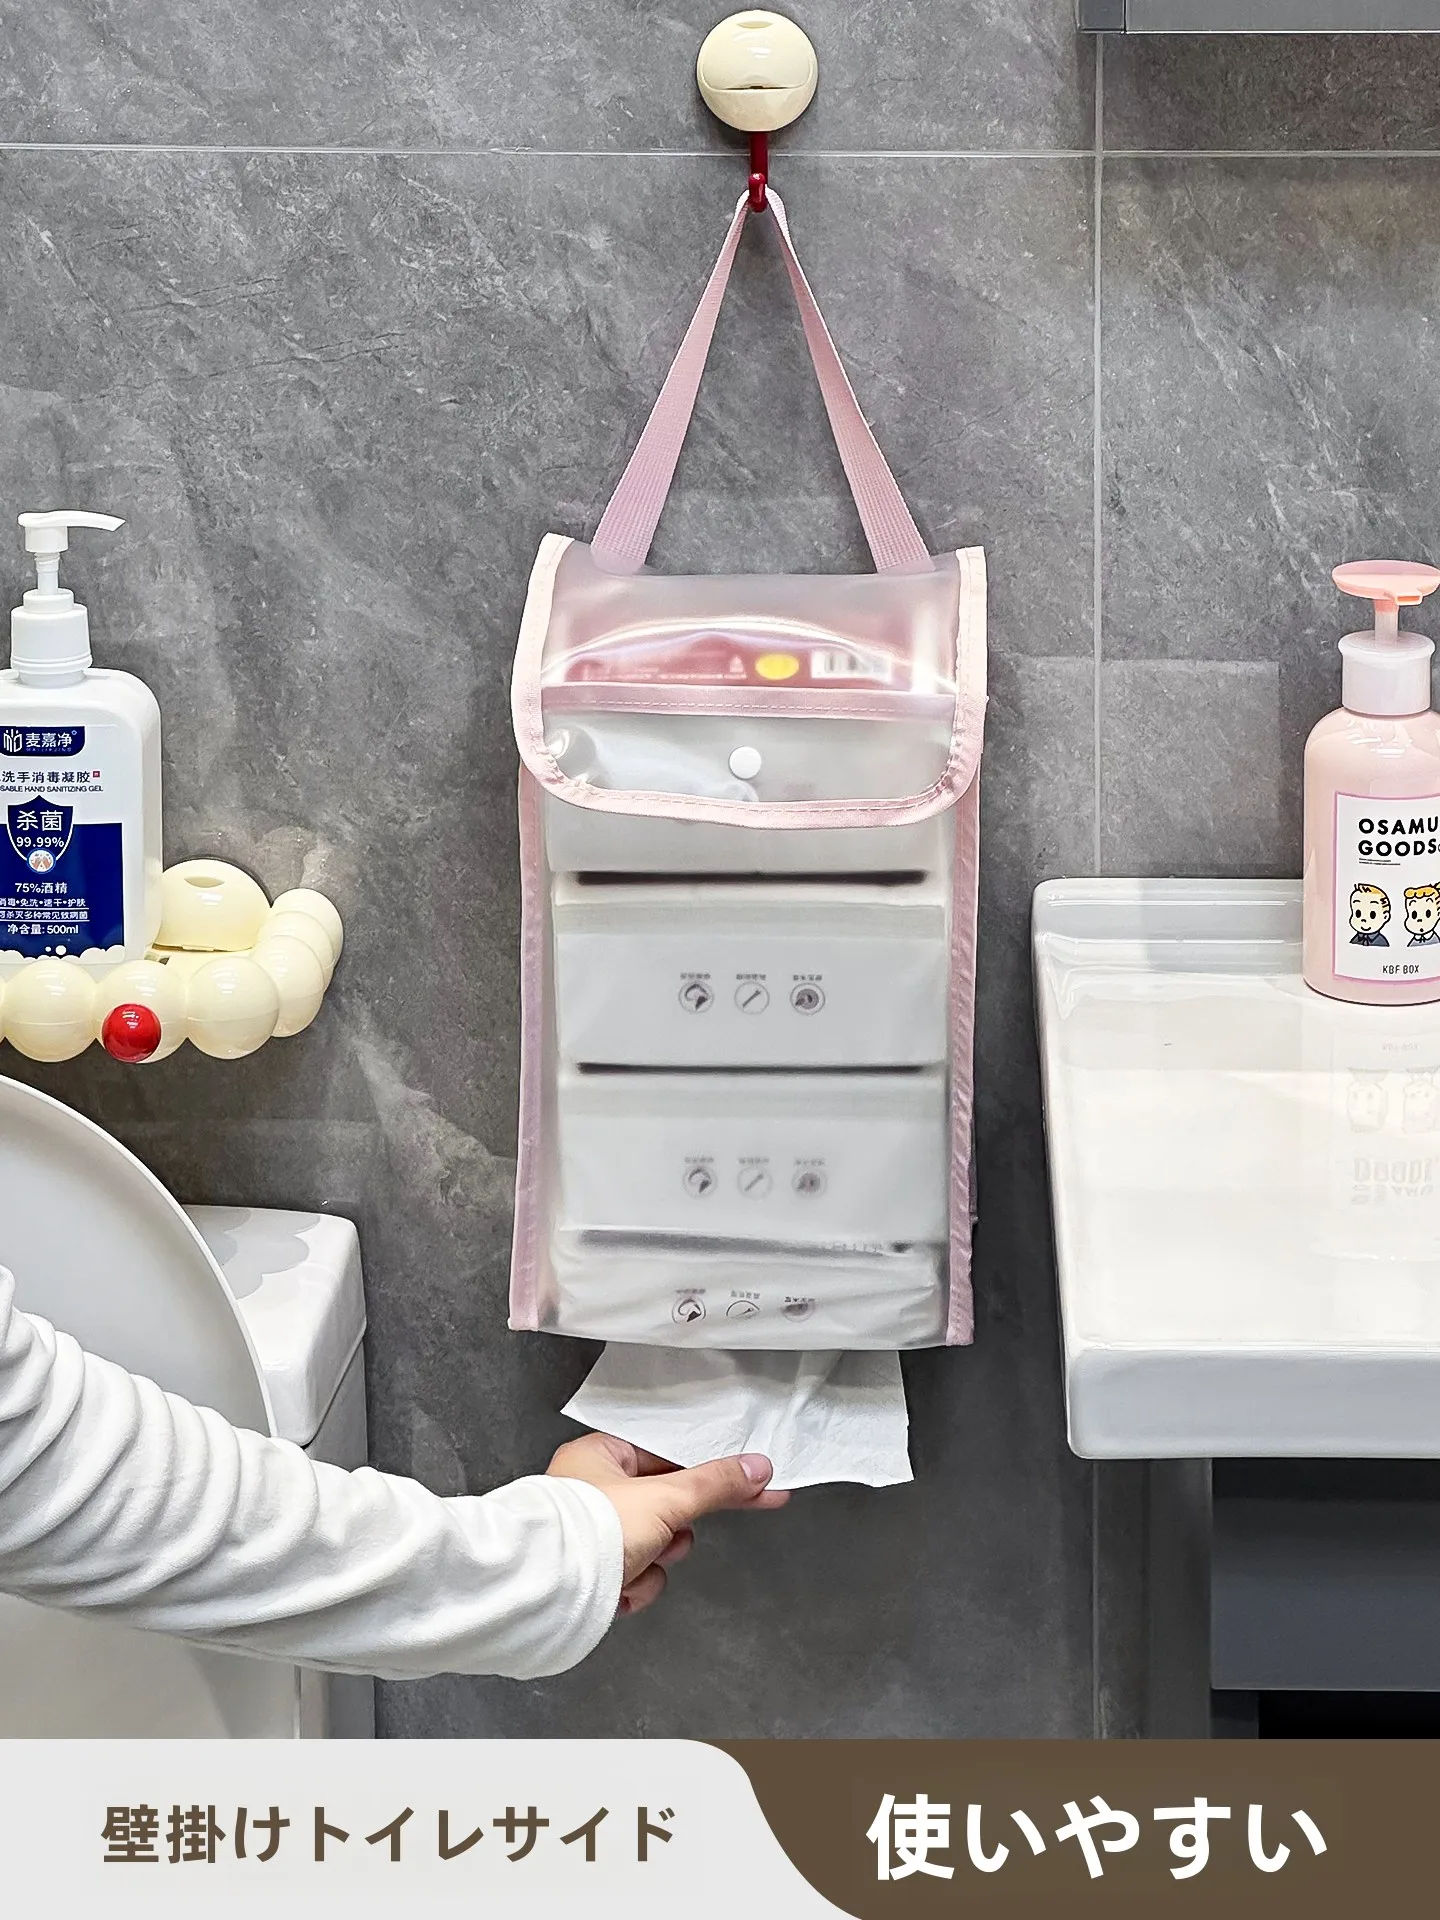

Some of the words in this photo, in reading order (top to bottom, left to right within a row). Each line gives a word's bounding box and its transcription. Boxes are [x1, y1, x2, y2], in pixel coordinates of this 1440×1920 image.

[25, 732, 73, 748] 麦嘉净
[0, 770, 91, 784] 洗手消毒凝胶
[24, 785, 46, 793] HAND
[46, 785, 88, 793] SANITIZING
[88, 785, 104, 793] GEL
[16, 809, 64, 832] 杀菌
[1358, 815, 1439, 836] OSAMU
[16, 836, 65, 848] 99.99%
[15, 881, 68, 894] 75%酒精
[1382, 964, 1400, 975] KBF
[1402, 964, 1420, 975] BOX
